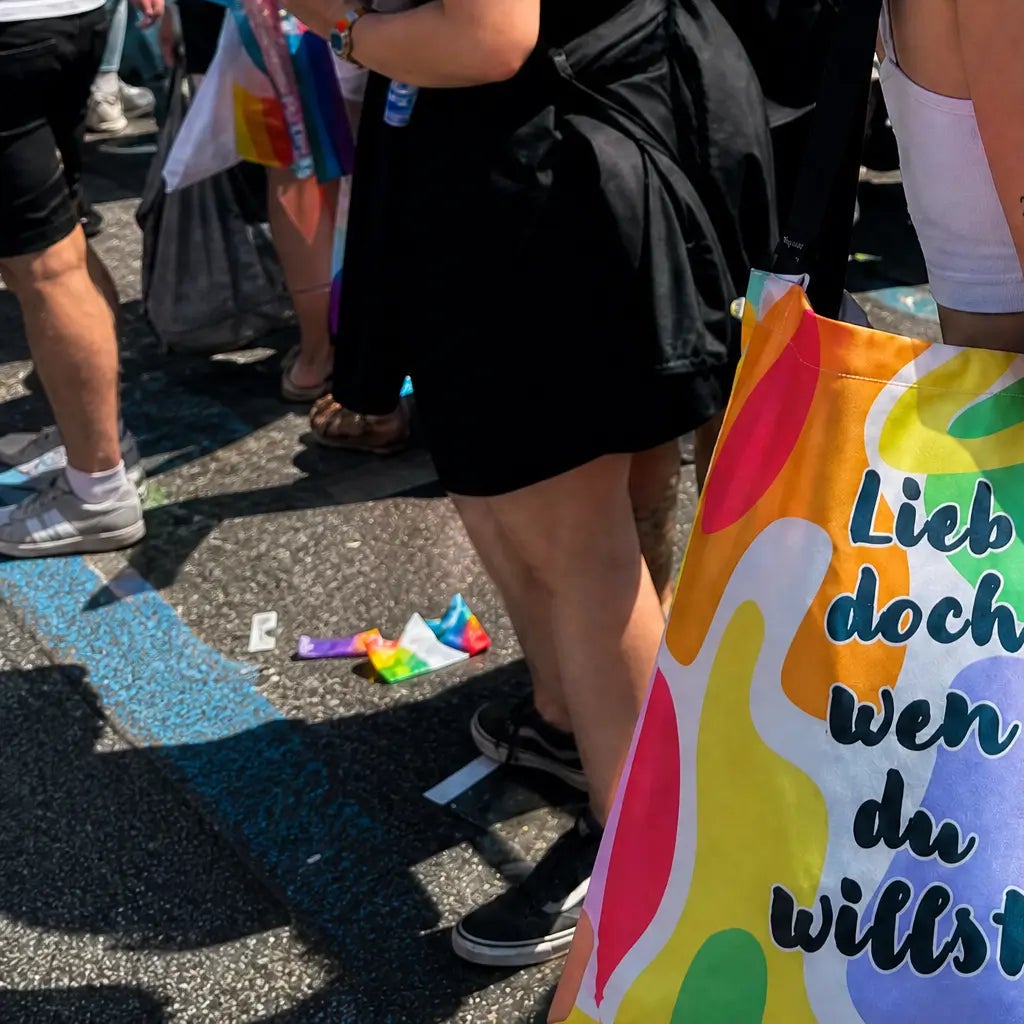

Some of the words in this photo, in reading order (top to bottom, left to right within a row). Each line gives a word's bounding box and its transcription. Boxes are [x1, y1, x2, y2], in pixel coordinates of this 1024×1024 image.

[850, 469, 1013, 555] Lieb
[829, 685, 1020, 756] wen
[853, 768, 976, 864] du
